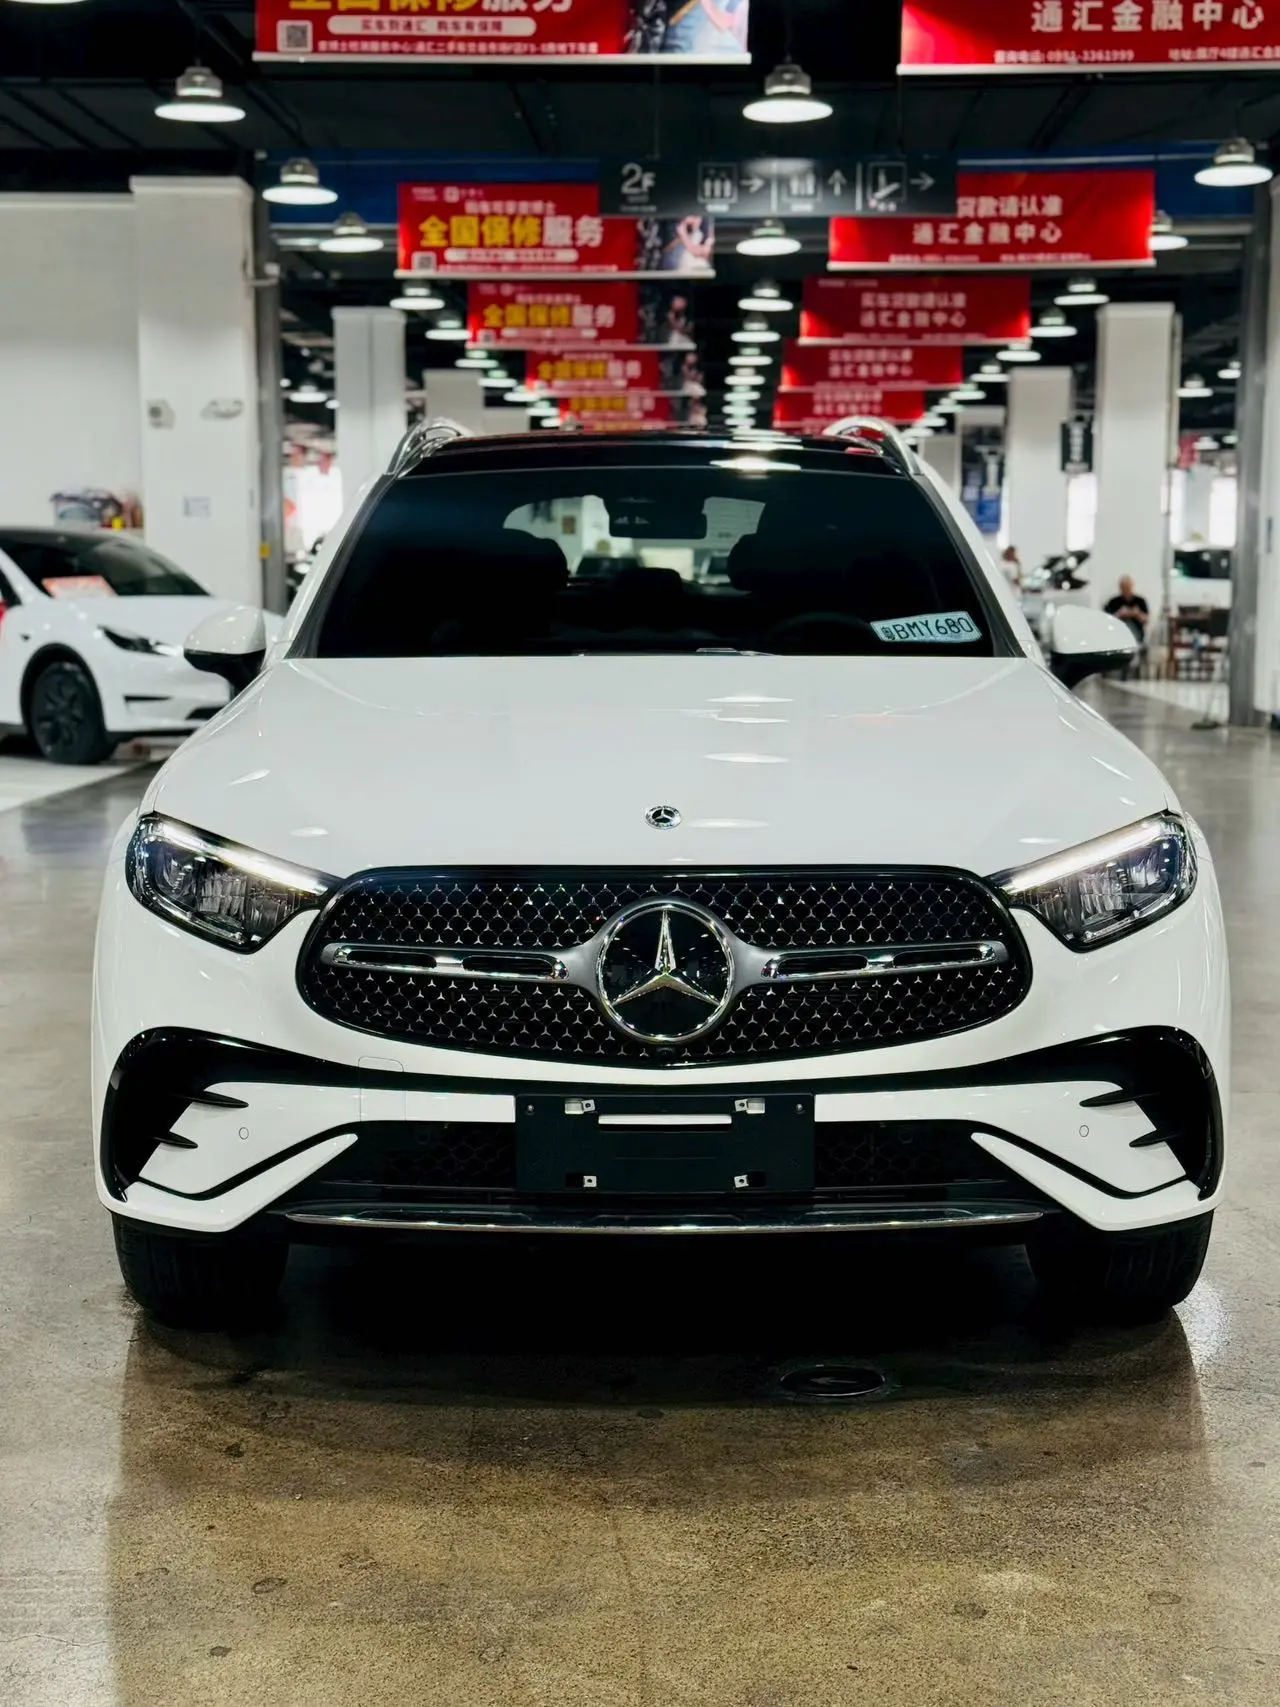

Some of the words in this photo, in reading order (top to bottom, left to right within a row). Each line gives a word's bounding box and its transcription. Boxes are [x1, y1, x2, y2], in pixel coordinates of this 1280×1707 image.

[1031, 0, 1265, 33] 通汇金融中心
[621, 162, 657, 194] 2F
[419, 214, 603, 248] 全国保修服务
[912, 221, 1063, 245] 通汇金融中心
